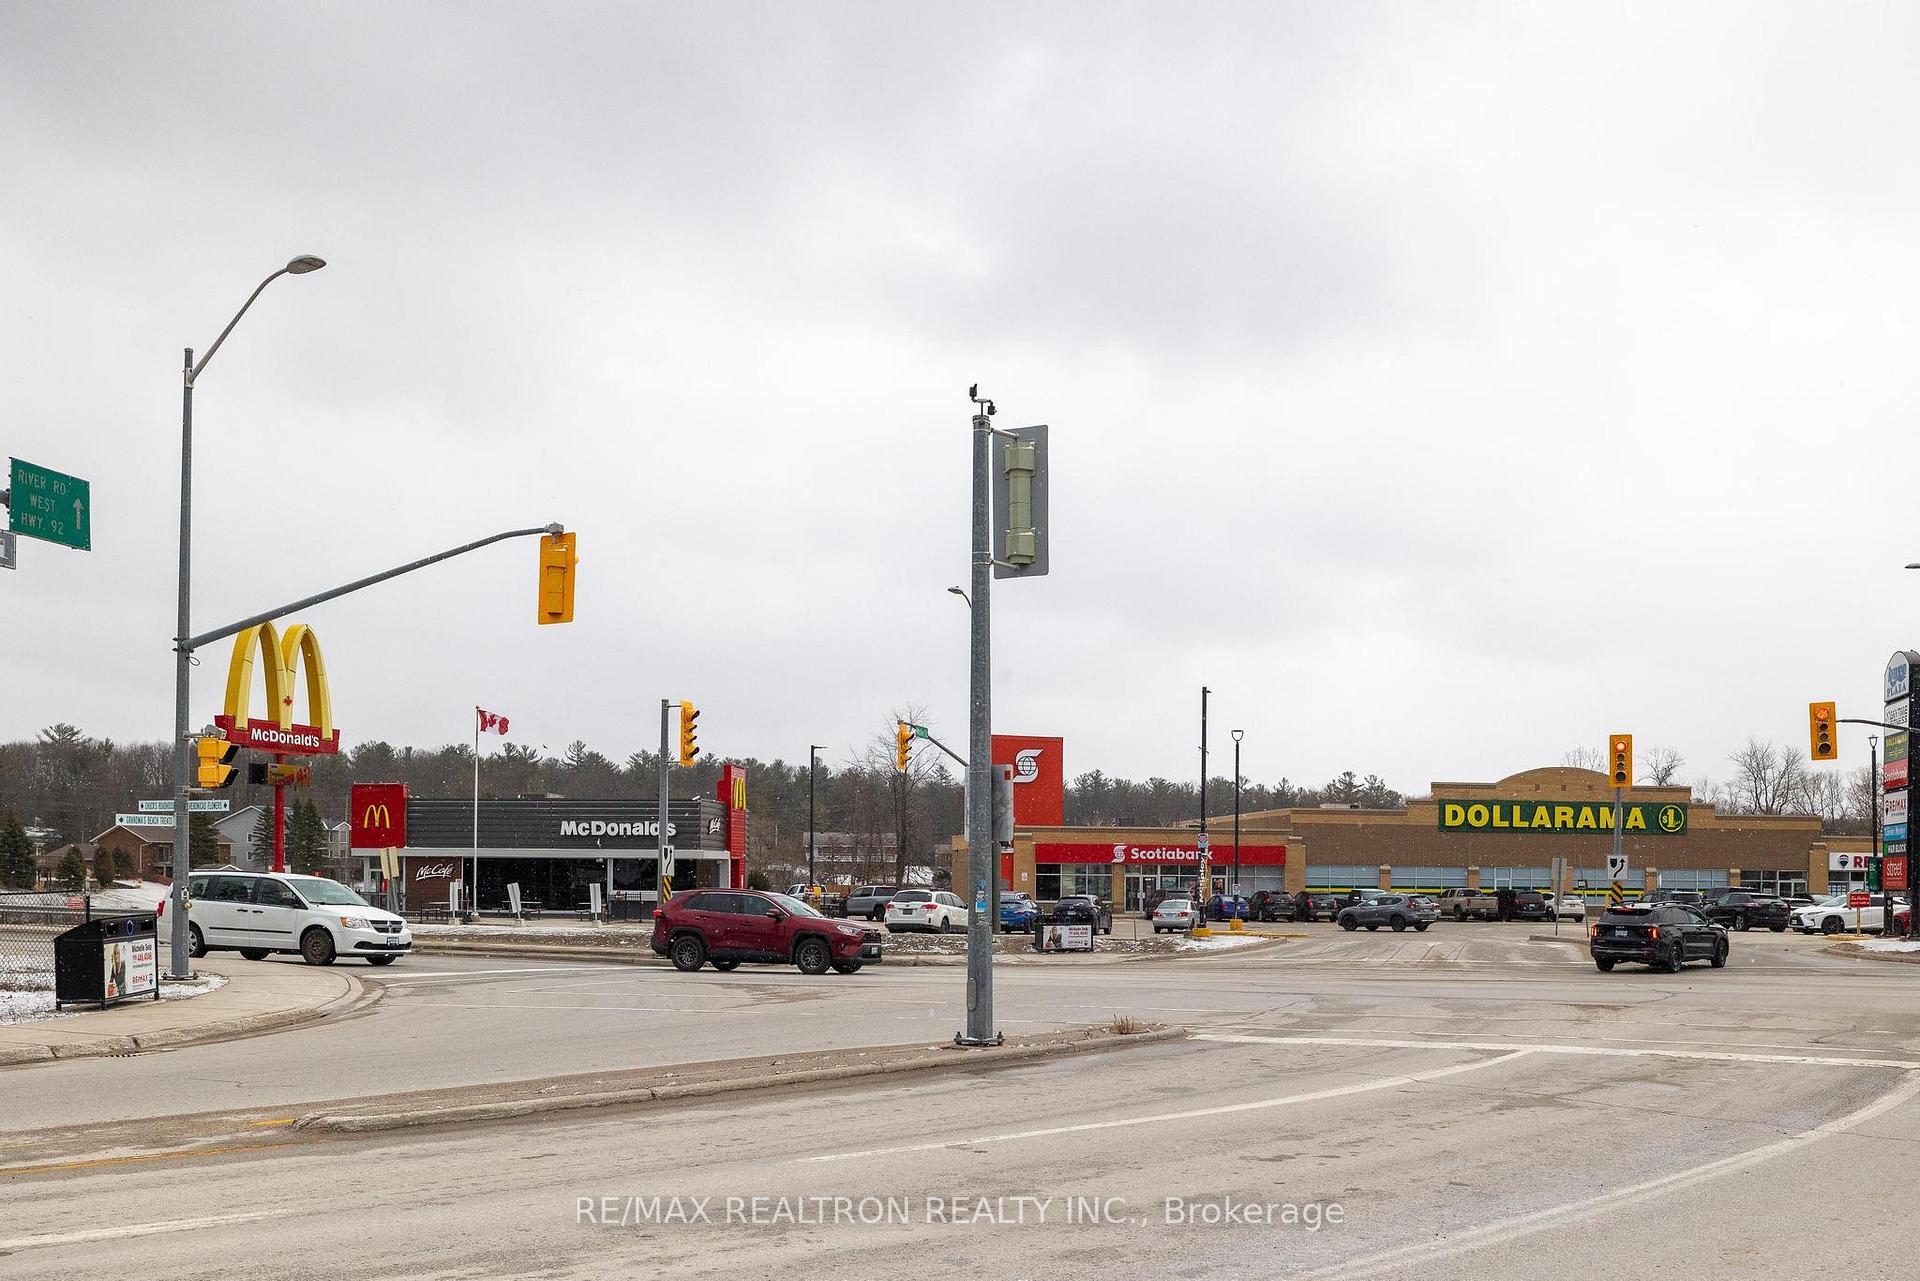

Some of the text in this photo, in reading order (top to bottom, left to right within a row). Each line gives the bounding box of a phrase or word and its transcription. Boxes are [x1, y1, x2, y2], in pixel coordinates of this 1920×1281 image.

[18, 469, 46, 490] RIVER
[30, 493, 55, 513] WEST
[51, 519, 64, 534] 92
[1887, 683, 1906, 698] PLAZA
[250, 727, 320, 747] McDonald's
[1444, 803, 1647, 830] DOLLARAMA
[1130, 846, 1214, 861] Scotiabank
